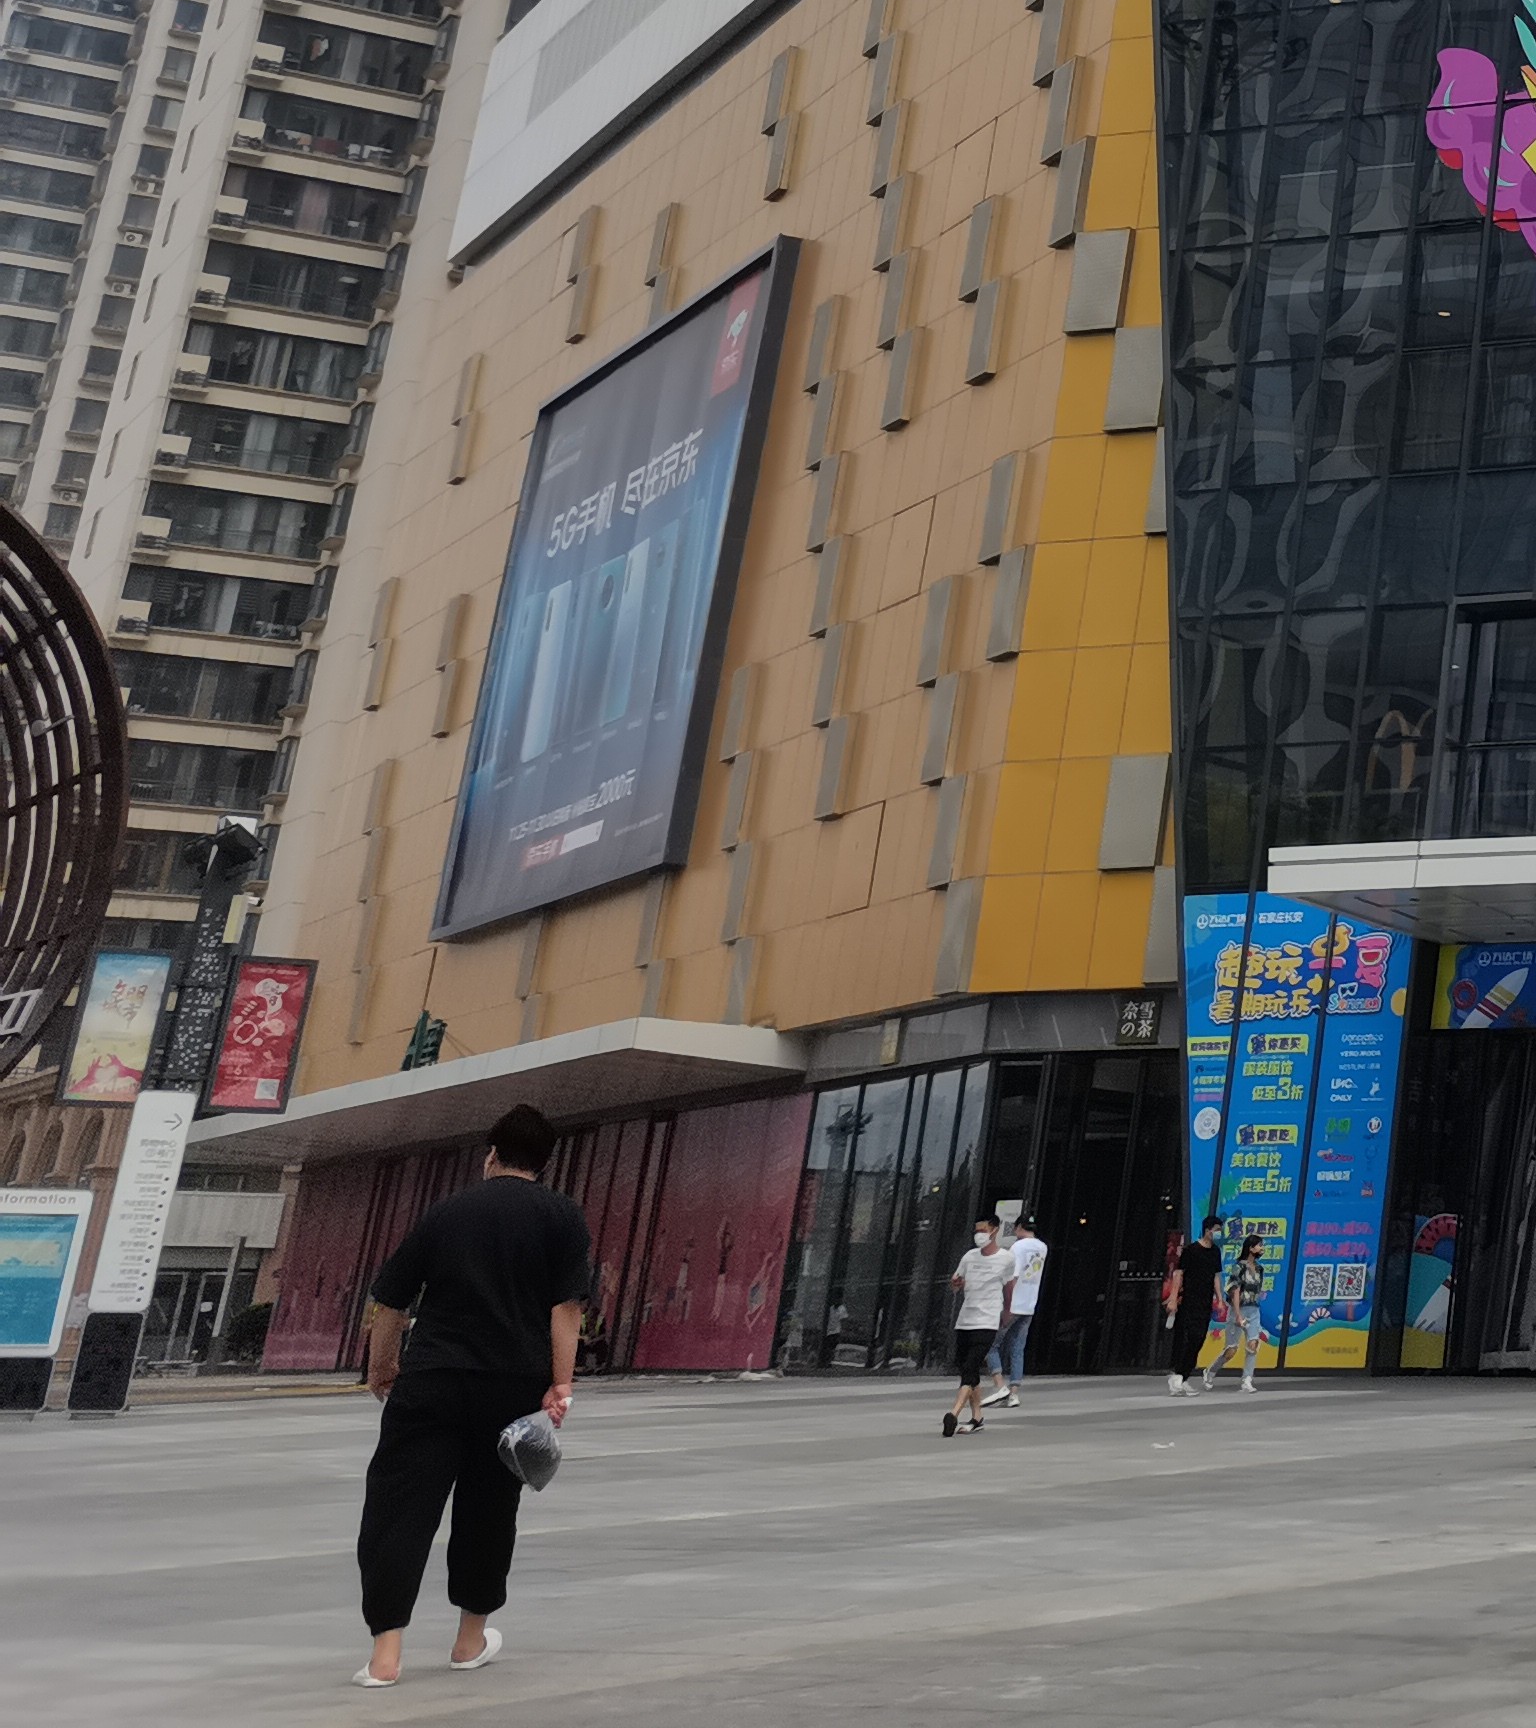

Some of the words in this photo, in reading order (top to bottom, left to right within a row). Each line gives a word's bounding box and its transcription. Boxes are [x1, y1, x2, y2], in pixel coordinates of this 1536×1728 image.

[547, 480, 618, 559] 5G手机
[621, 428, 704, 516] 尽在京东
[1252, 1076, 1304, 1102] 低至3折
[1238, 1169, 1292, 1193] 低至5折
[0, 1192, 77, 1205] formation
